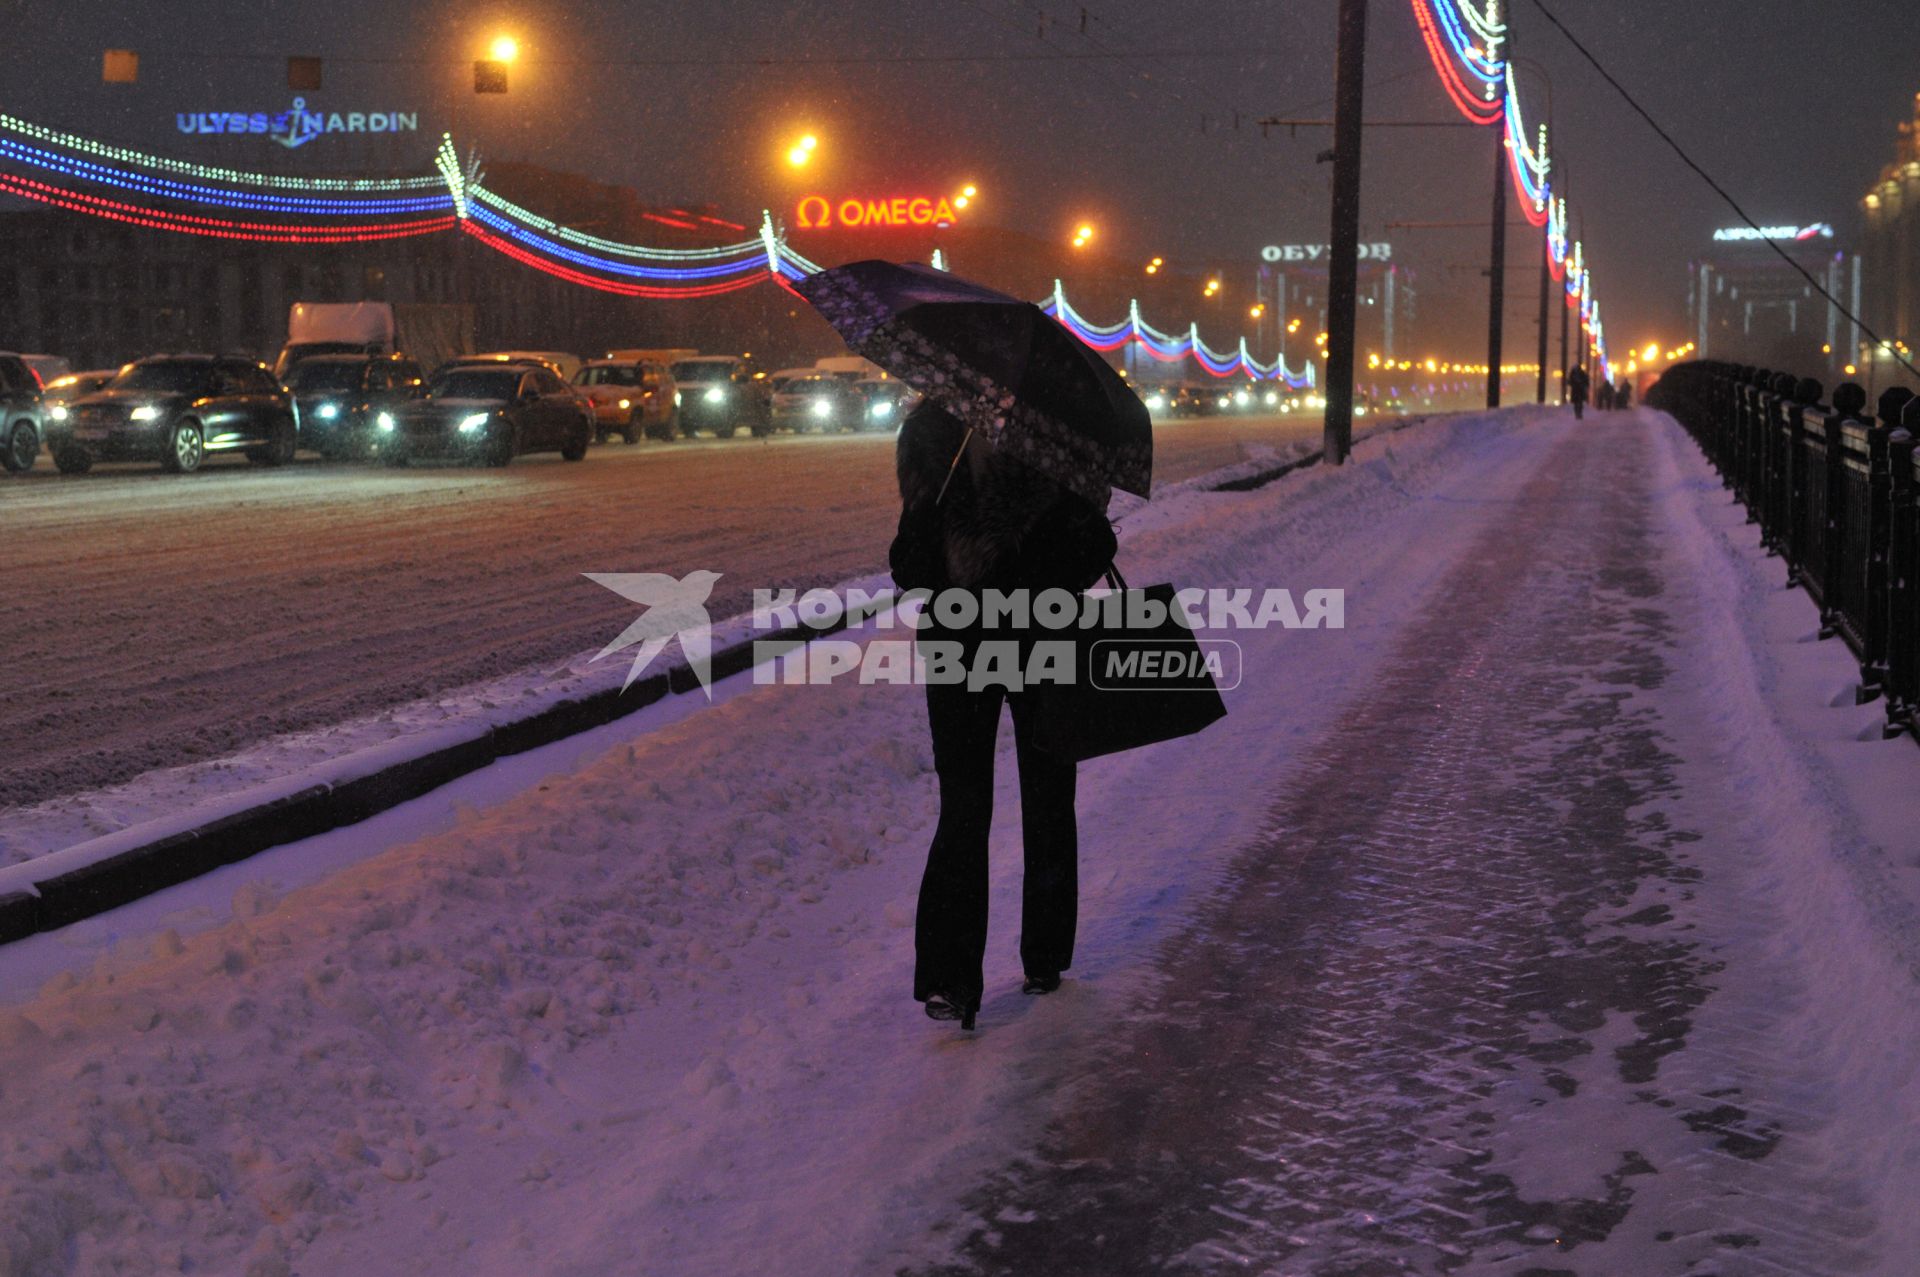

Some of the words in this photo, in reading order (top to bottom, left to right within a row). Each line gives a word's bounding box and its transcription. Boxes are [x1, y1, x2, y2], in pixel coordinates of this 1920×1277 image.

[302, 112, 417, 133] NARDIN
[838, 197, 957, 227] OMEGA
[1261, 242, 1392, 262] ОБУОВ
